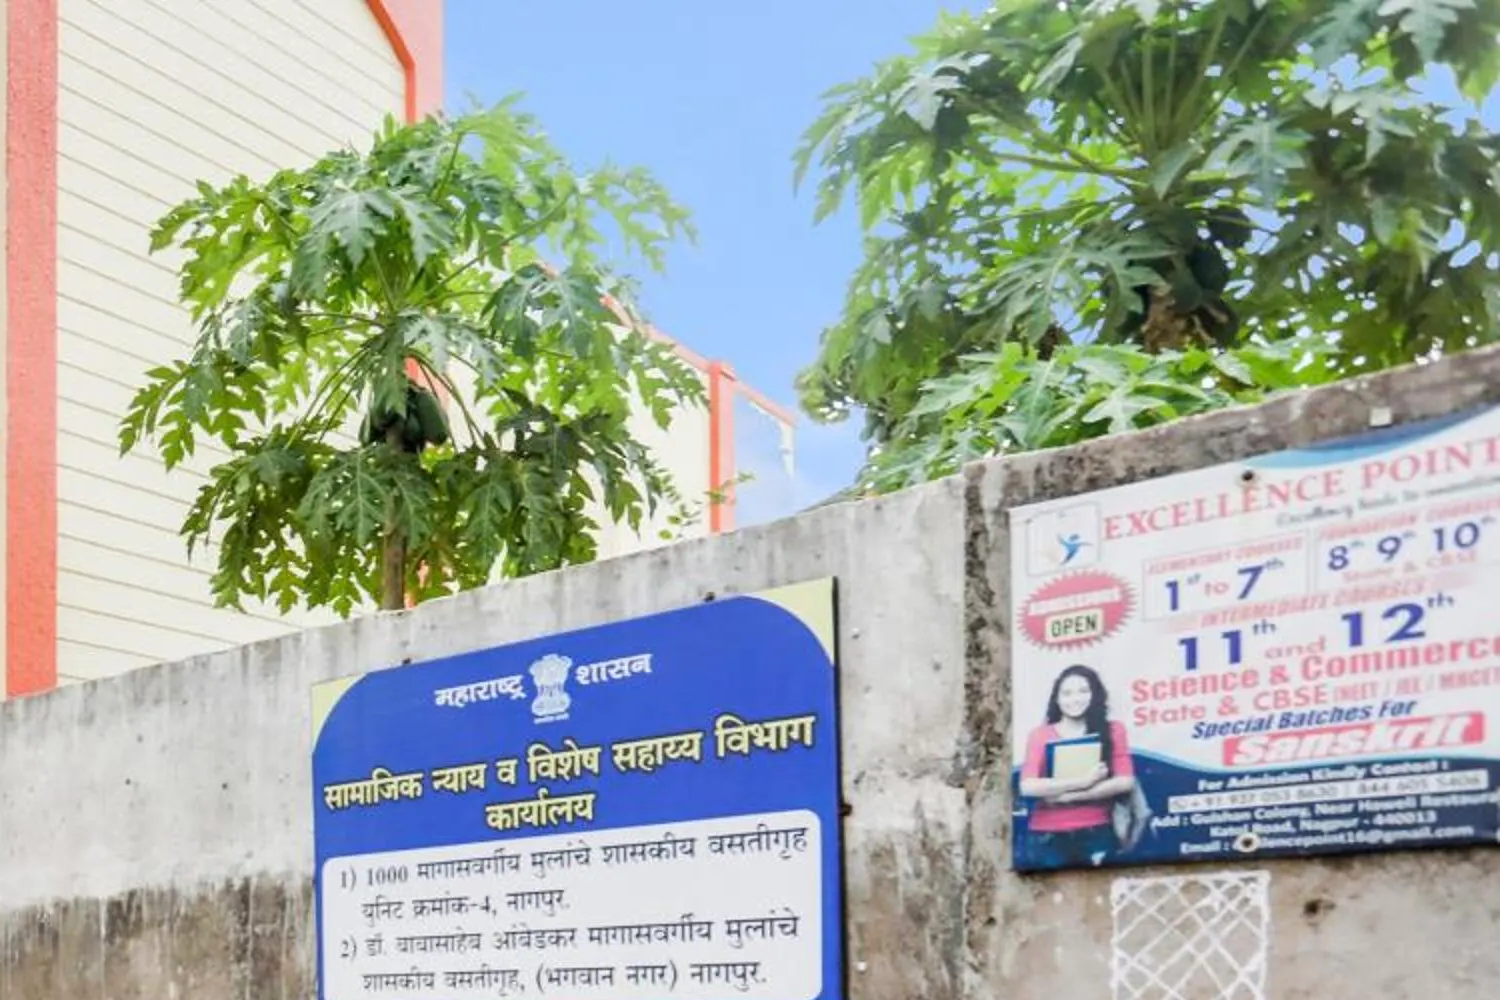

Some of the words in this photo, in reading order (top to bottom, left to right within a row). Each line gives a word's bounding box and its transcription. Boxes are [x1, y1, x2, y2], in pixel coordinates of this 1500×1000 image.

[1103, 470, 1345, 540] EXCELLENCE
[1205, 579, 1229, 597] to
[1237, 558, 1285, 600] 7th
[1051, 613, 1098, 637] OPEN
[1178, 619, 1277, 671] 11th
[1264, 635, 1326, 660] and
[1340, 592, 1454, 647] 12th
[433, 675, 527, 707] महाराष्ट्र
[575, 653, 653, 685] शासन
[1131, 668, 1260, 704] Science
[1269, 664, 1290, 686] &
[1133, 704, 1206, 727] State
[1217, 695, 1240, 716] &
[1253, 683, 1328, 711] CBSE
[1192, 713, 1274, 740] Special
[1277, 704, 1373, 729] Batches
[1378, 699, 1418, 718] For
[324, 767, 424, 810] सामाजिक
[432, 763, 487, 793] न्याय
[496, 758, 518, 785] व
[528, 740, 601, 783] विशेष
[612, 731, 704, 772] सहाय्य
[714, 714, 816, 758] विभाग
[485, 788, 596, 831] कार्यालय
[341, 867, 357, 891] 1)
[366, 866, 409, 887] 1000
[417, 848, 521, 880] मागासवर्गीय
[531, 839, 591, 879] मुलांचे
[600, 832, 698, 867] शासकीय
[707, 823, 809, 860] वसतीगृह
[588, 912, 714, 945] मागासवर्गीय
[725, 907, 800, 949] मुलांचे
[361, 966, 436, 992] शासकीय
[626, 960, 678, 992] नगर)
[689, 961, 767, 992] नागपुर.
